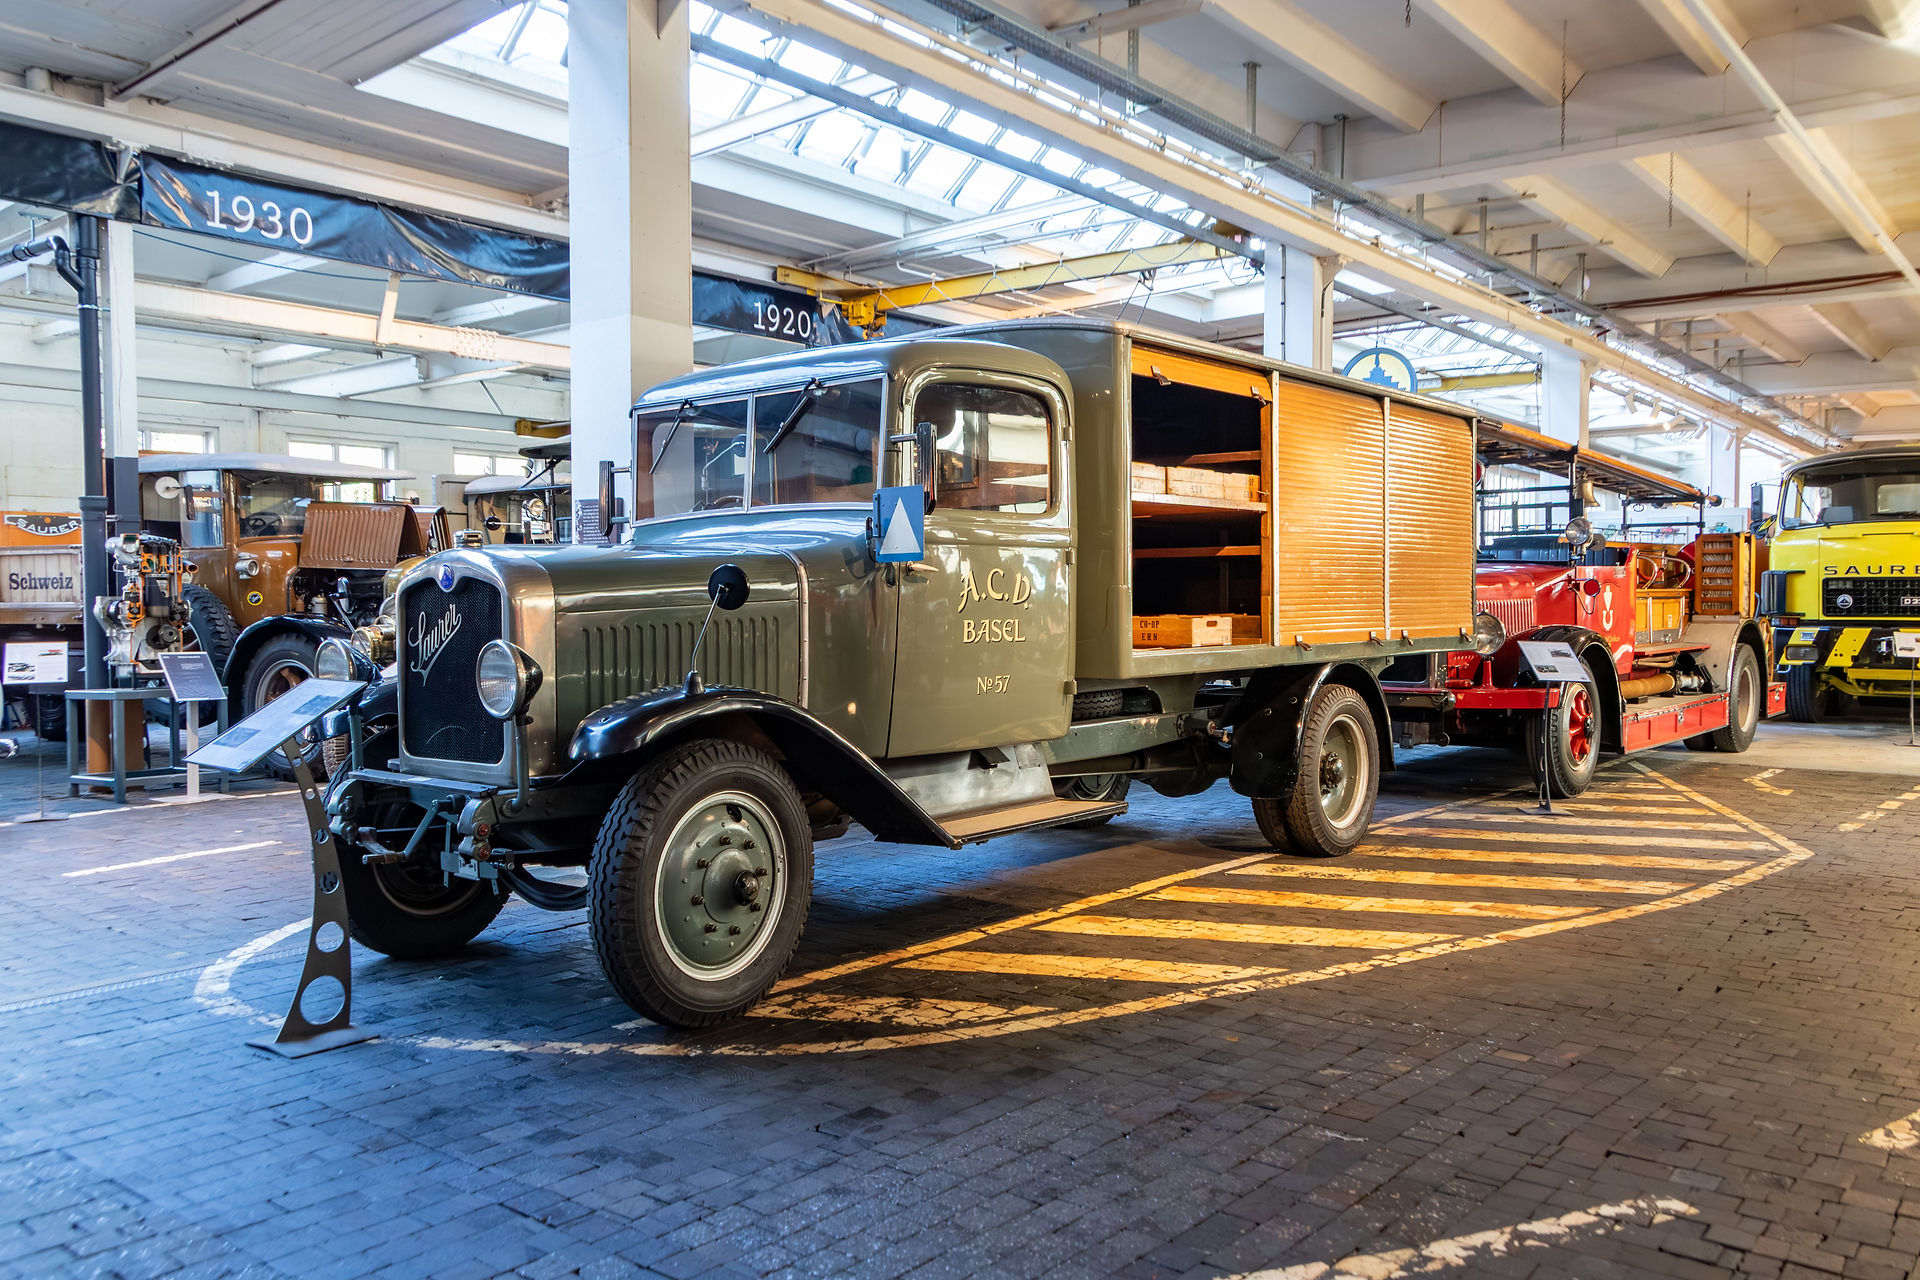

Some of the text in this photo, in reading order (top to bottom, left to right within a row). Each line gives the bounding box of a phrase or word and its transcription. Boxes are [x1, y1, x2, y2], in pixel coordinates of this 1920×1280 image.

[206, 189, 313, 245] 1930
[753, 301, 811, 338] 1920
[17, 518, 80, 534] SAURER
[9, 572, 73, 591] Schweiz
[963, 619, 1026, 643] BASEL
[408, 603, 461, 687] Saurer
[995, 675, 1011, 694] 57
